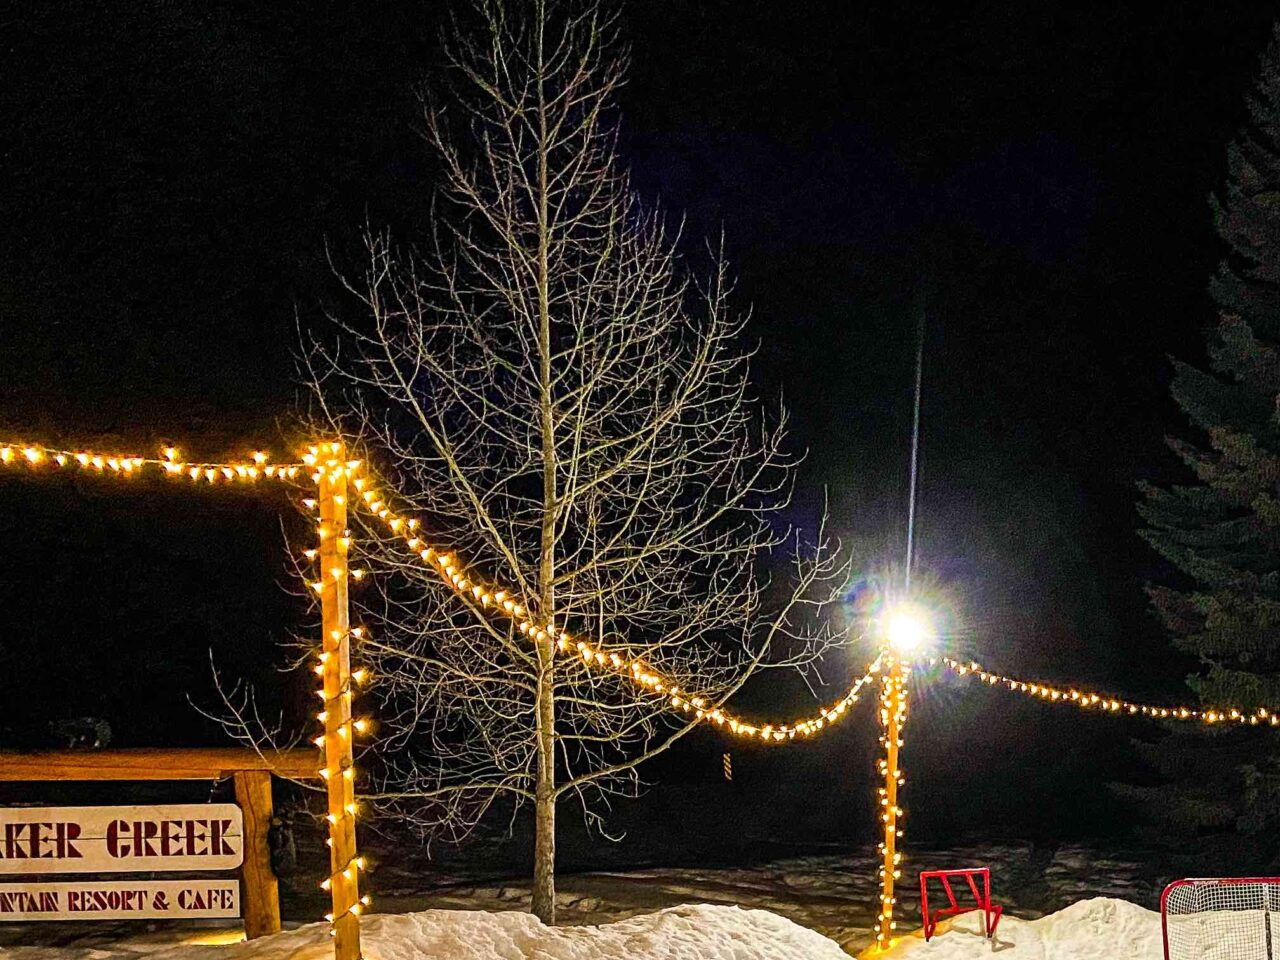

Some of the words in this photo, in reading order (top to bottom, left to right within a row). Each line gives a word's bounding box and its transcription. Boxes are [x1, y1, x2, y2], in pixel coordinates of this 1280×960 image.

[0, 822, 83, 859] KER
[106, 819, 236, 858] CREEK
[68, 890, 148, 911] RESORT
[152, 890, 170, 911] &
[178, 889, 234, 910] CAFE
